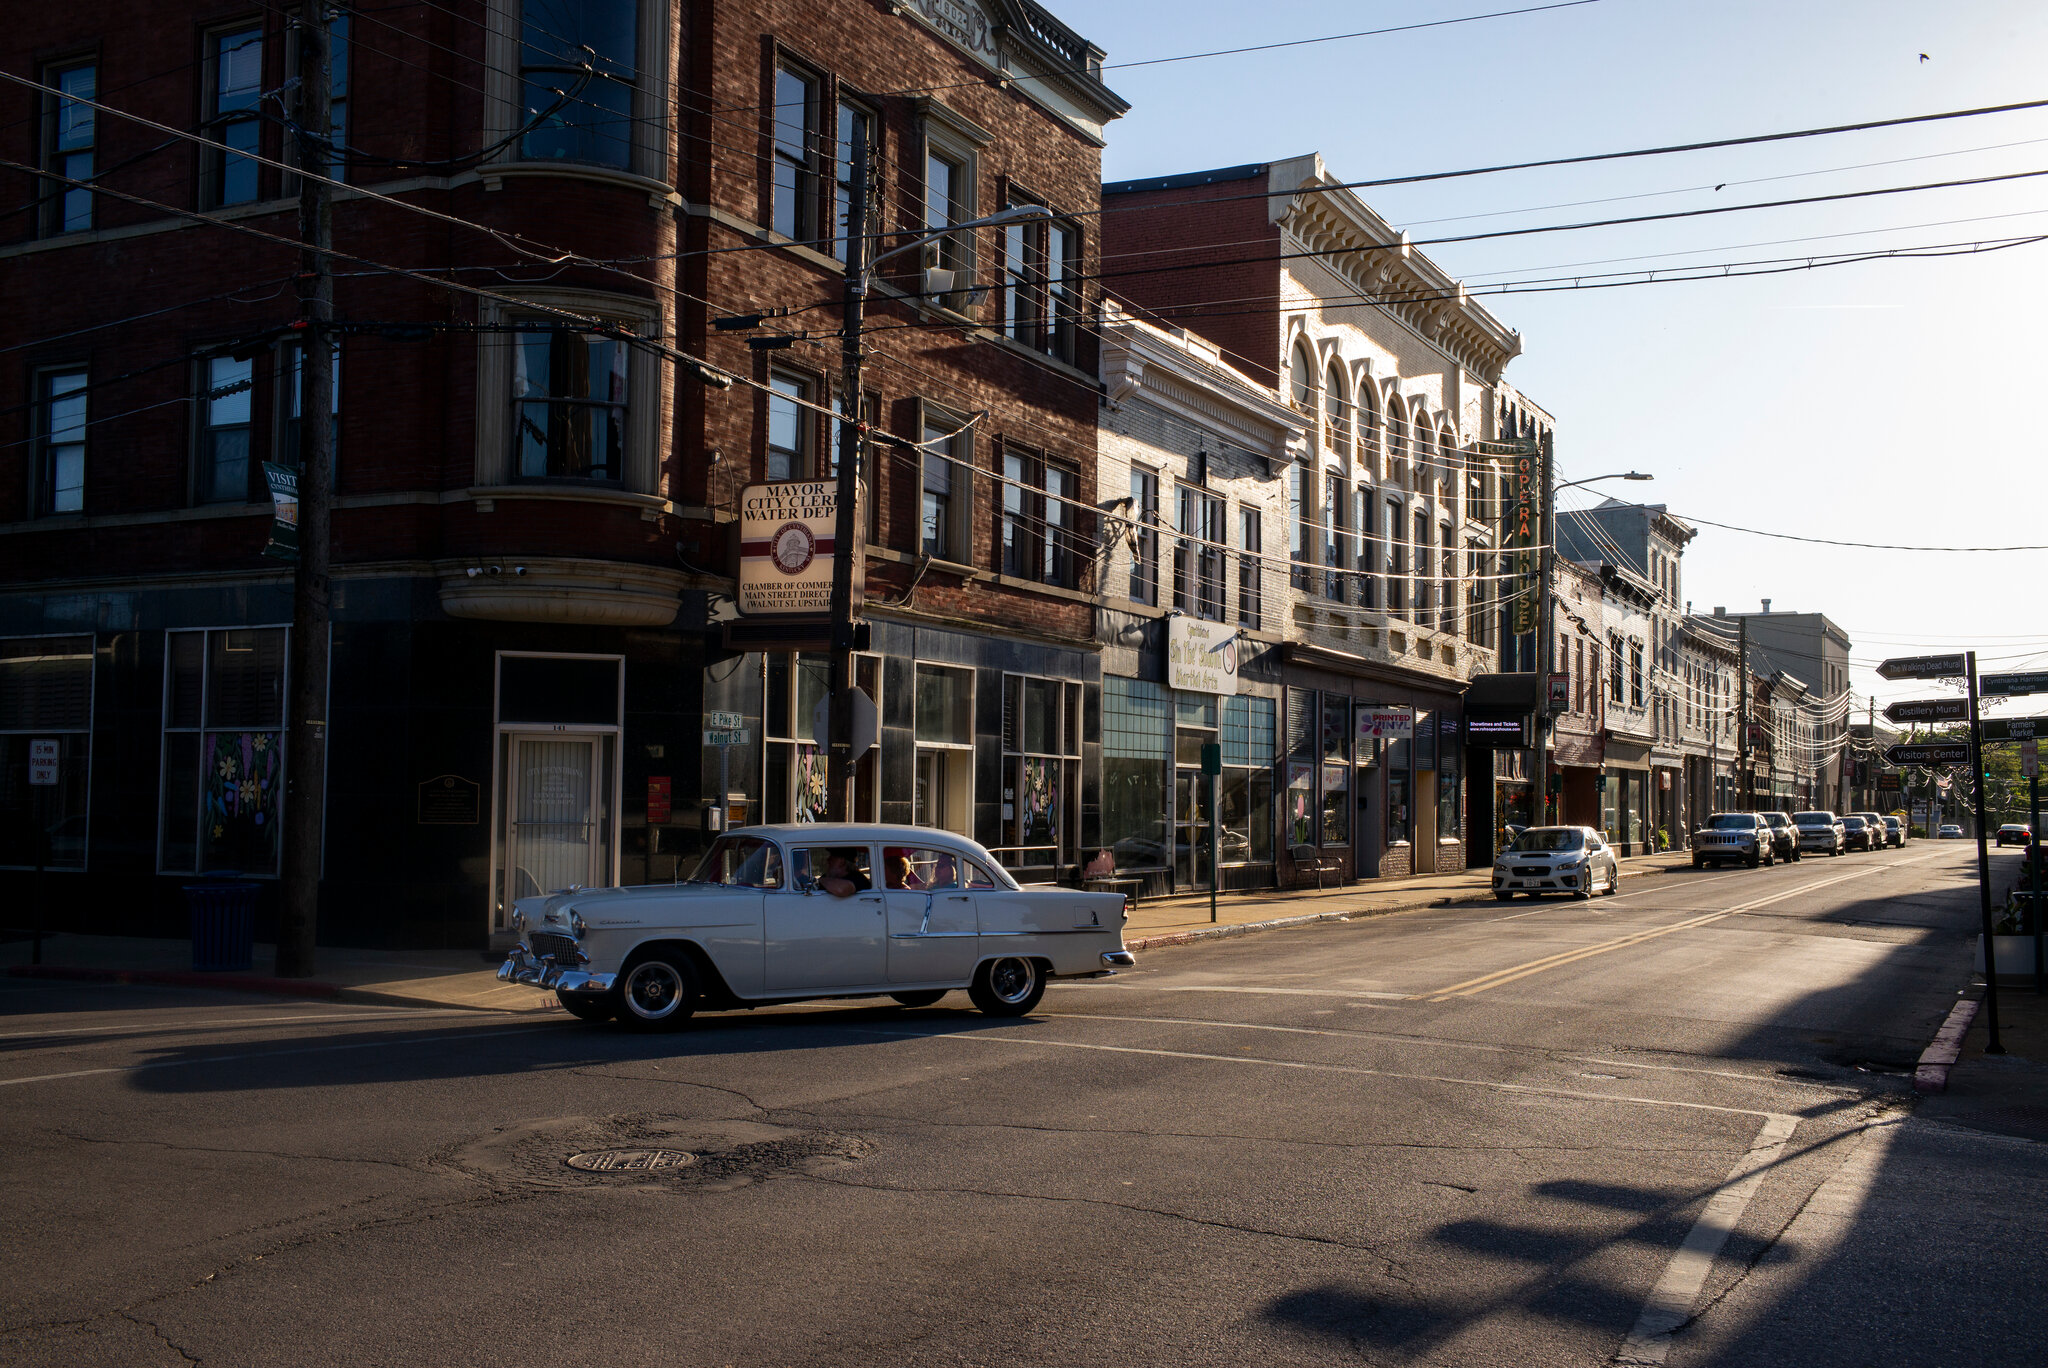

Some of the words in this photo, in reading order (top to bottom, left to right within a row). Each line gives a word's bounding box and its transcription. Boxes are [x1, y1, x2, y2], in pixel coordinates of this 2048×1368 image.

[268, 471, 298, 488] VISIT
[766, 484, 824, 497] MAYOR
[748, 497, 786, 510] CITY
[1520, 458, 1530, 538] OPERA
[744, 508, 798, 520] WATER
[804, 506, 837, 518] DEP
[742, 582, 782, 590] CHAMBER
[784, 582, 794, 590] OF
[1520, 547, 1530, 624] HOUSE
[744, 592, 766, 600] MAIN
[747, 600, 783, 608] (WALNUT
[1890, 664, 1900, 672] The
[1901, 664, 1926, 672] Walking
[1926, 661, 1942, 670] Dead
[1944, 660, 1960, 668] Mural
[1175, 666, 1200, 688] Martial
[1202, 670, 1218, 690] Arts
[1899, 706, 1934, 716] Distillery
[1936, 704, 1960, 714] Mural
[712, 714, 717, 724] E
[719, 714, 731, 726] Pike
[734, 714, 740, 727] St
[1374, 722, 1411, 730] VINYL
[710, 731, 731, 743] Walnut
[734, 730, 740, 742] St
[2010, 729, 2033, 737] Market
[1897, 751, 1930, 760] Visitors
[1934, 750, 1965, 758] Center
[32, 758, 56, 767] PARKING
[37, 770, 50, 780] ONLY
